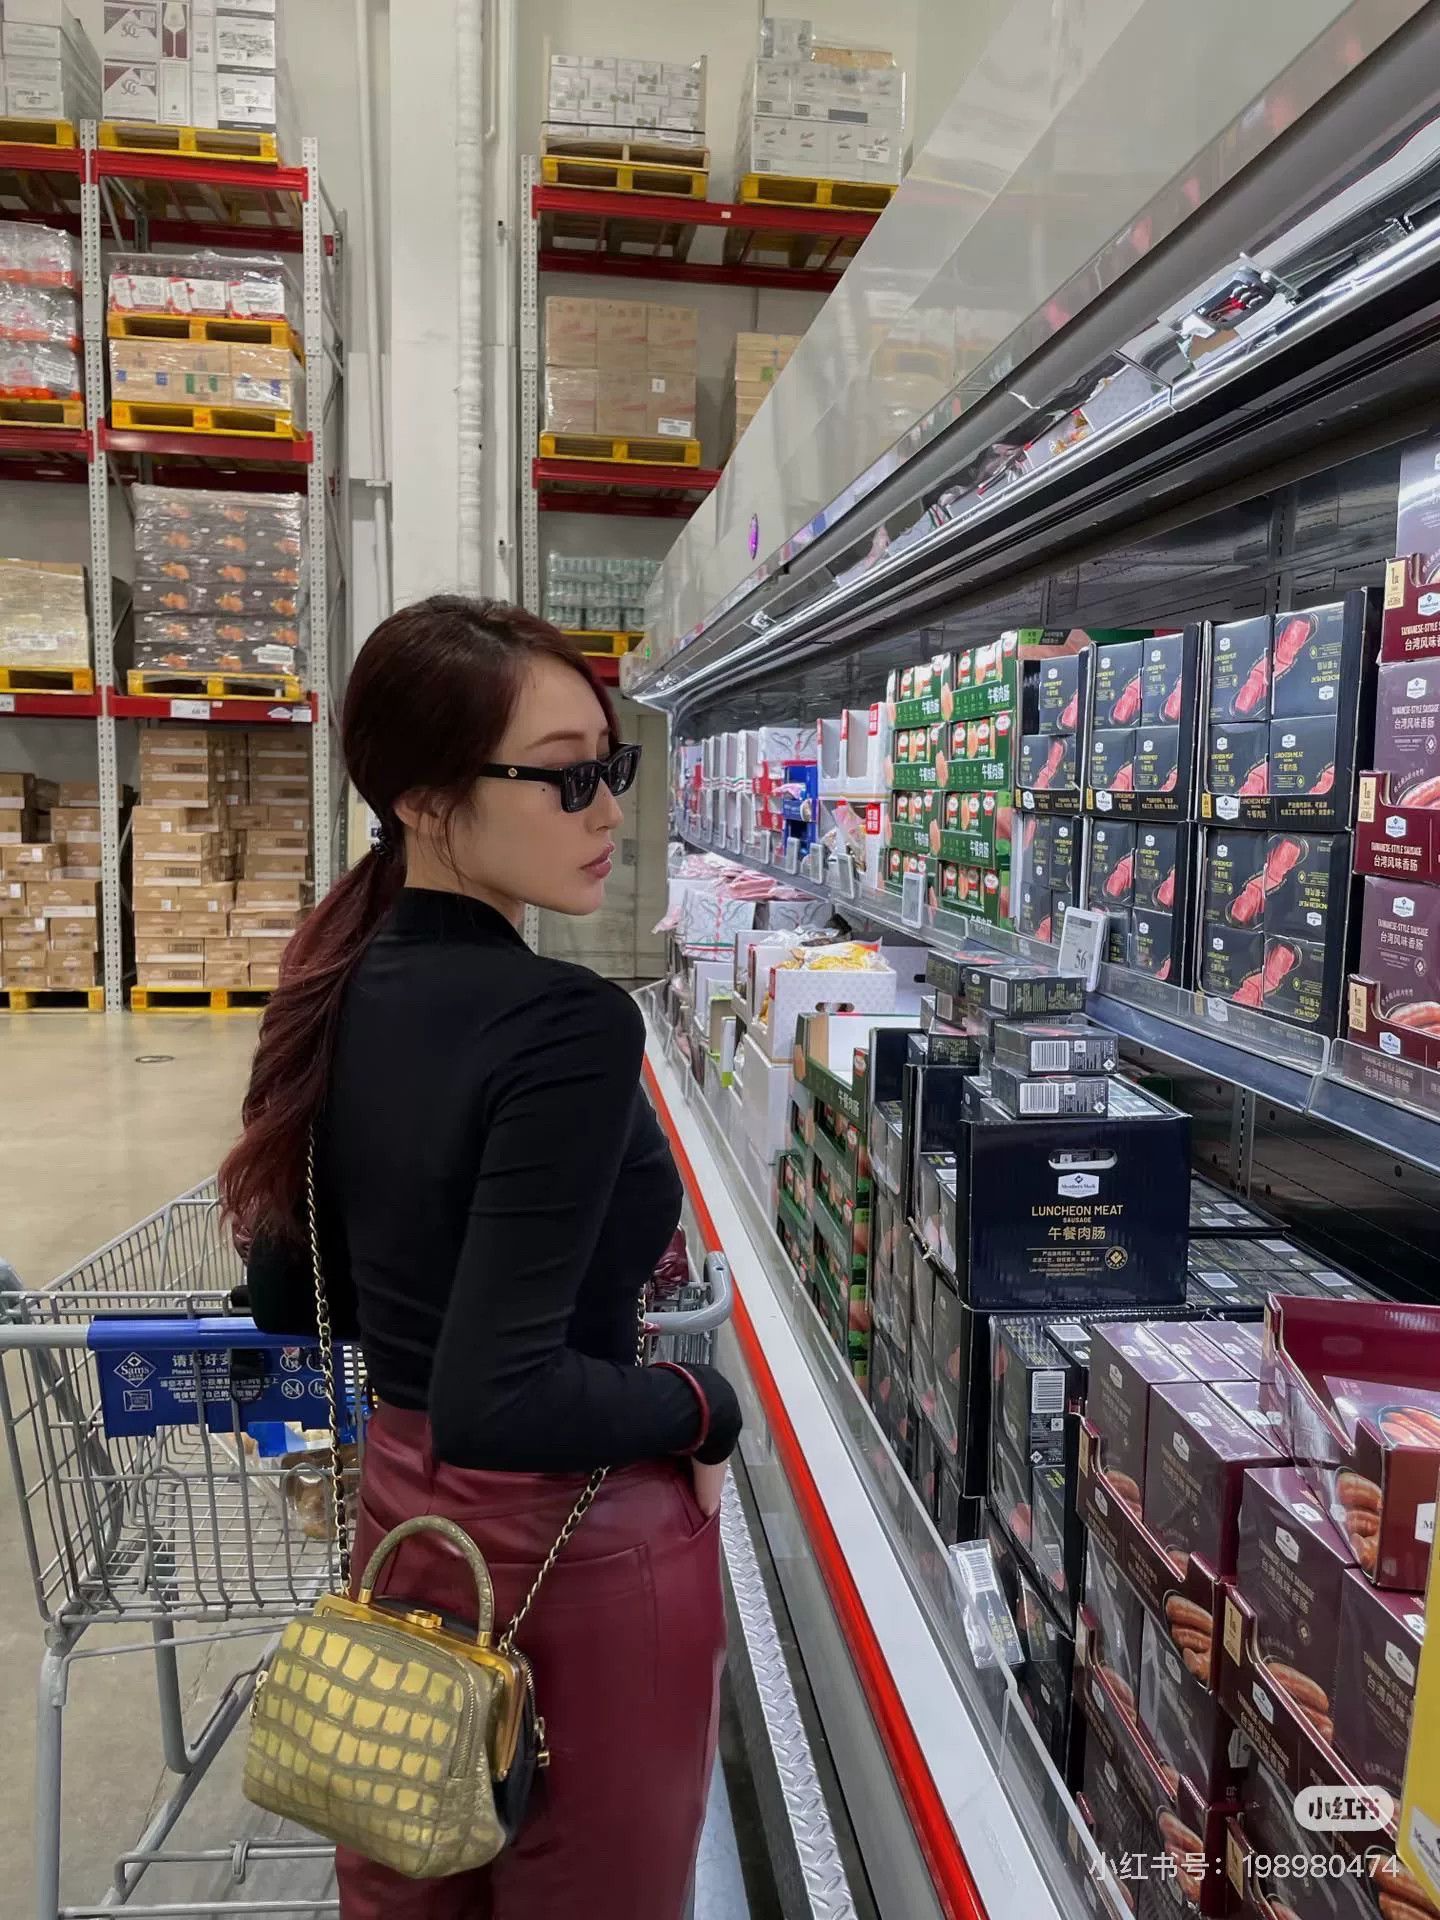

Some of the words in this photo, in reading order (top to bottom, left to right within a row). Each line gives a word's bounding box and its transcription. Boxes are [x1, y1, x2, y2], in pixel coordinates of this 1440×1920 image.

[1394, 716, 1435, 729] 台湾风味香肠
[1374, 854, 1418, 872] 台湾风味香肠
[1380, 930, 1424, 951] 台湾风味香肠
[1031, 1205, 1092, 1217] LUNCHEON
[1094, 1204, 1124, 1216] MEAT
[1048, 1226, 1106, 1240] 午餐肉肠
